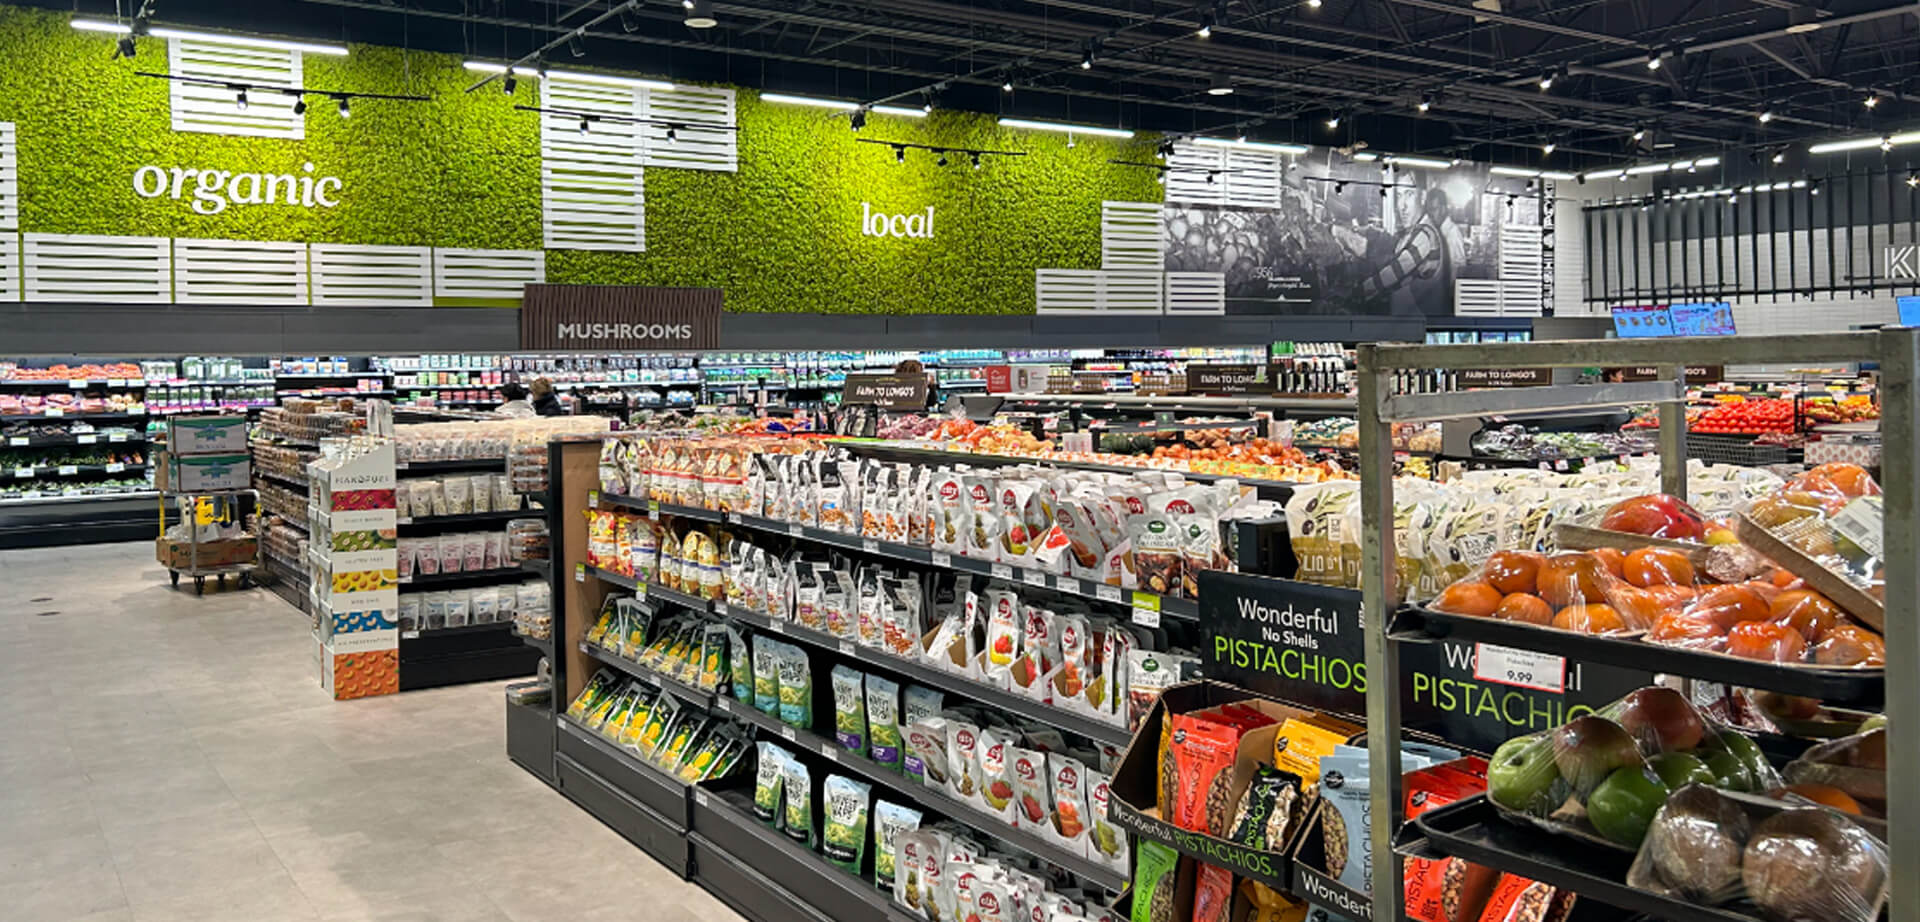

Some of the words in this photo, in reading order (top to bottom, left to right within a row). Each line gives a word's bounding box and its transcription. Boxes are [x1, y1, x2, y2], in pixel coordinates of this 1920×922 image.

[133, 162, 342, 215] organic
[861, 203, 934, 238] local
[558, 323, 692, 339] MUSHROOMS
[1221, 375, 1233, 384] TO
[1465, 370, 1488, 379] FARM
[1489, 370, 1500, 379] TO
[1501, 370, 1537, 379] LONGO'S
[876, 386, 885, 397] TO
[1237, 597, 1338, 635] Wonderful
[1262, 627, 1281, 642] No
[1282, 631, 1319, 649] Shells
[1215, 635, 1368, 693] PISTACHIOS
[1507, 670, 1533, 682] 9.99
